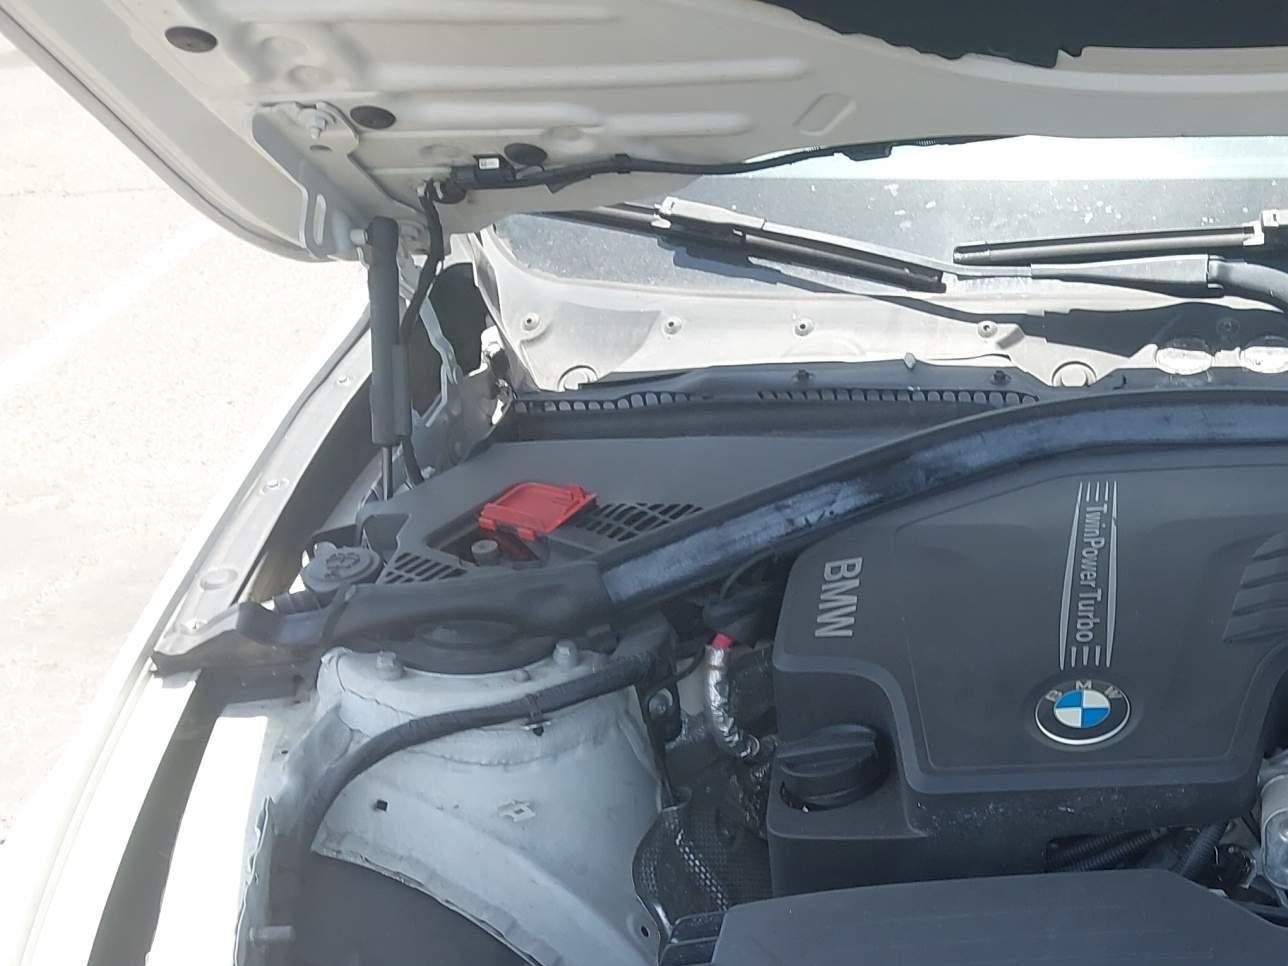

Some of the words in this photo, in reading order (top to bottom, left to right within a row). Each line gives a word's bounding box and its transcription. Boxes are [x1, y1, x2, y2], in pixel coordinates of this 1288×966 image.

[1079, 503, 1108, 587] TwinPower
[815, 556, 863, 637] BMW
[1075, 588, 1102, 642] Turbo
[1045, 680, 1122, 702] BMW
